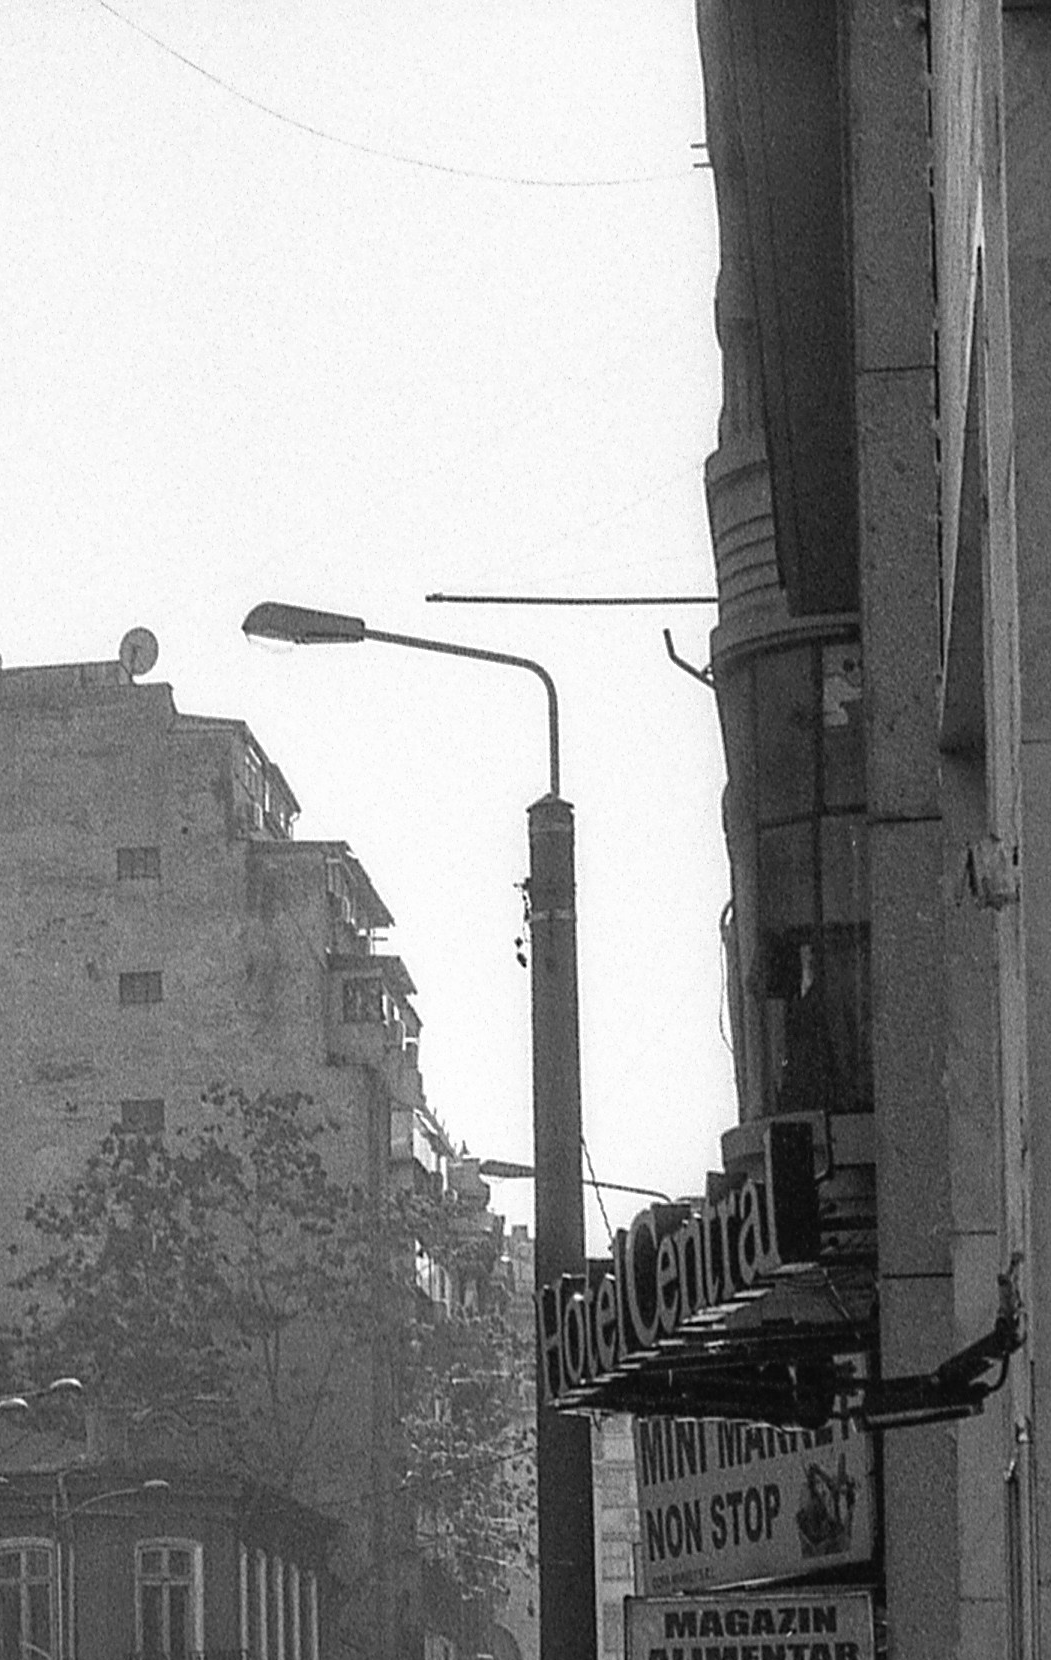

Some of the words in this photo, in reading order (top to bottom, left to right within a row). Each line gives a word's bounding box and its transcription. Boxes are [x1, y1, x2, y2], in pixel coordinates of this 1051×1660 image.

[537, 1235, 628, 1399] Hotel
[625, 1127, 782, 1347] Central
[640, 1420, 707, 1486] MINI
[646, 1499, 703, 1562] NON
[710, 1483, 780, 1550] STOP
[664, 1606, 837, 1639] MAGAZIN
